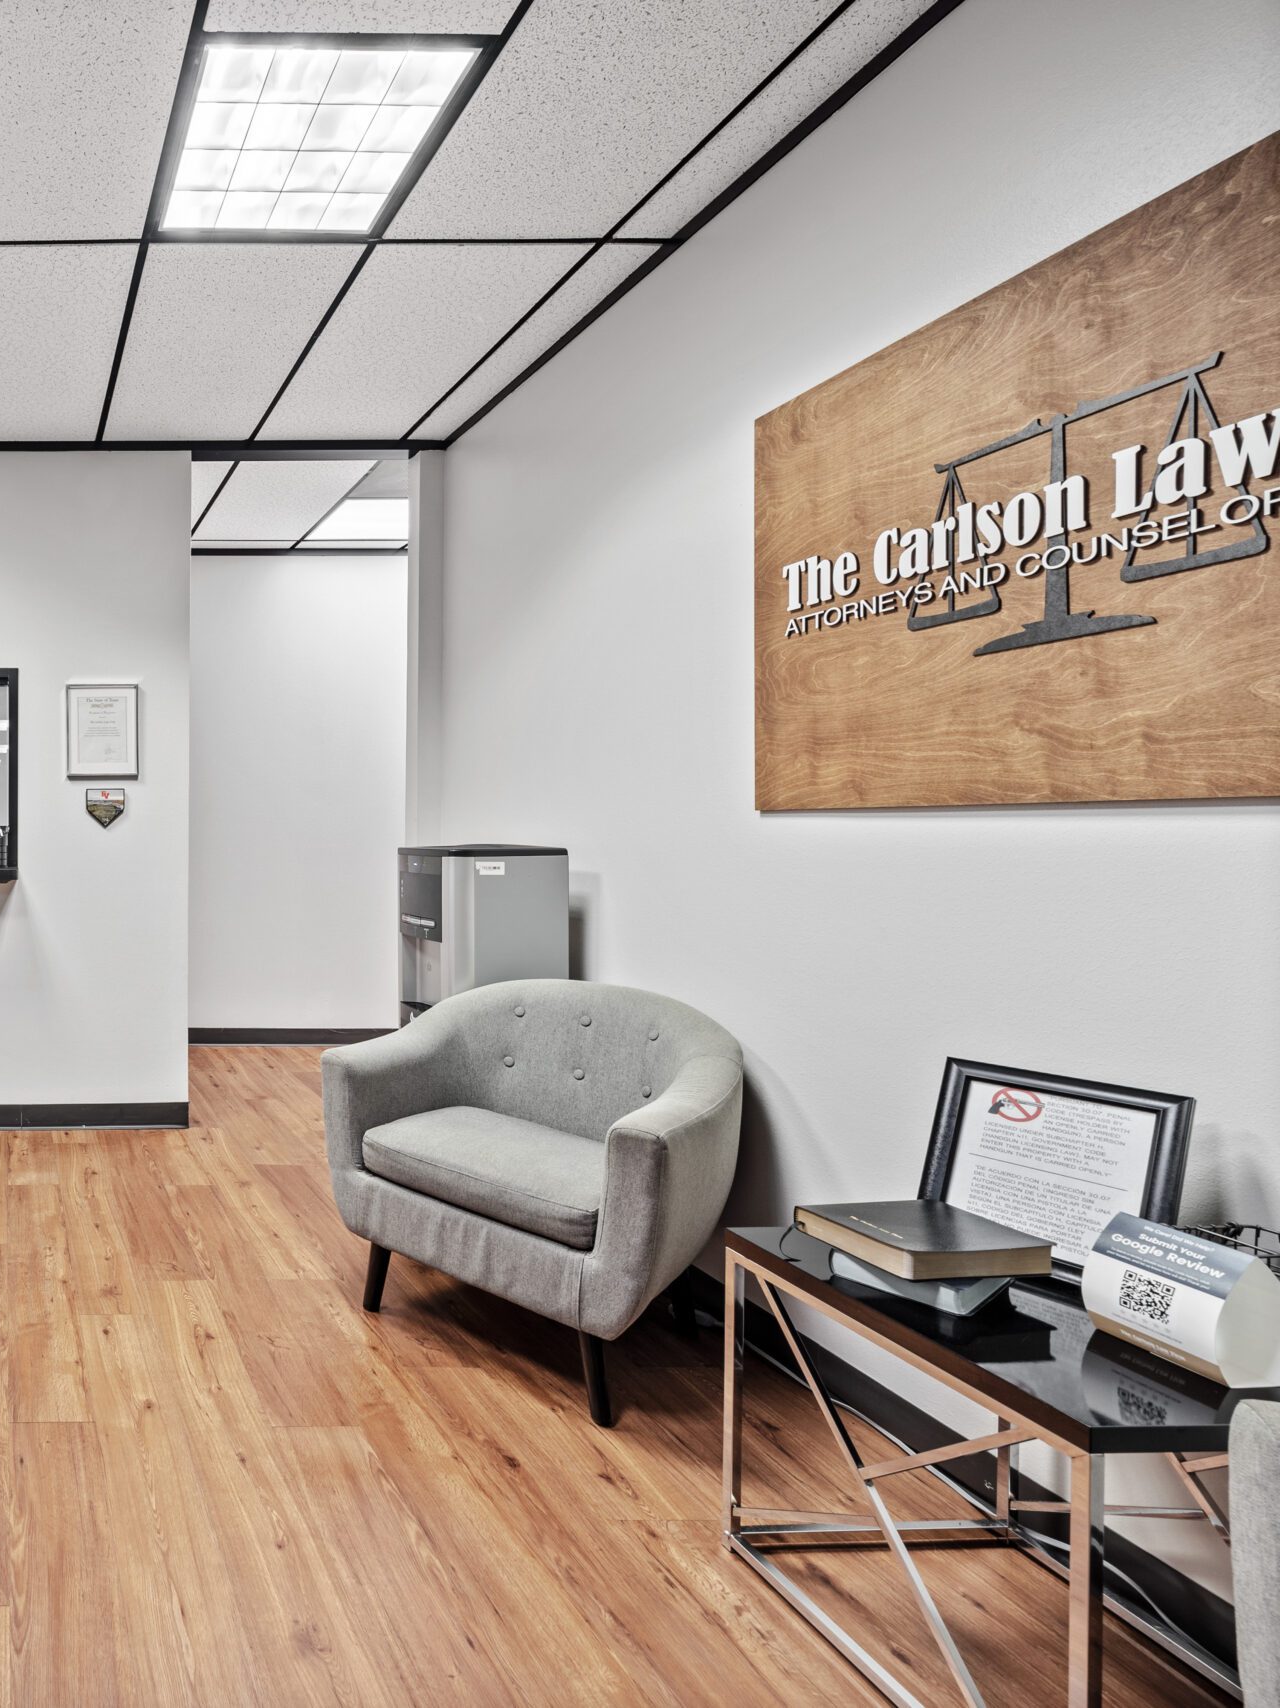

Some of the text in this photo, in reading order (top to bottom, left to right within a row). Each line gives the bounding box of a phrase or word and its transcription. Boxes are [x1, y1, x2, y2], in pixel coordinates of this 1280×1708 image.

[782, 407, 1280, 612] The Carlson Law
[785, 581, 934, 637] ATTORNEYS
[939, 562, 1007, 599] AND
[1045, 1106, 1065, 1115] CODE
[984, 1120, 1018, 1131] LICENSED
[1018, 1127, 1044, 1137] UNDER
[1045, 1133, 1095, 1148] SUBCHAPTER
[1044, 1112, 1130, 1134] LICENSE HOLDER WITH
[1055, 1121, 1084, 1131] OPENLY
[1086, 1127, 1121, 1139] CARRIED
[981, 1137, 1003, 1146] ENTER
[1022, 1146, 1061, 1159] PROPERTY
[1062, 1156, 1081, 1164] WITH
[983, 1126, 1015, 1136] CHAPTER
[1031, 1136, 1081, 1151] GOVERNMENT
[1083, 1148, 1106, 1157] CODE
[1093, 1135, 1126, 1146] PERSON
[979, 1143, 1013, 1155] HANDGUN
[1015, 1151, 1033, 1159] THAT
[1043, 1158, 1077, 1169] CARRIED
[1020, 1140, 1058, 1152] LICENSING
[1083, 1154, 1100, 1162] MAY
[1101, 1158, 1119, 1166] NOT
[987, 1167, 1022, 1180] ACUERDO
[1023, 1176, 1039, 1184] CON
[1017, 1180, 1040, 1190] PENAL
[995, 1194, 1010, 1202] UNA
[1011, 1198, 1046, 1211] PERSONA
[1047, 1207, 1065, 1216] CON
[1002, 1189, 1018, 1197] CON
[1020, 1194, 1035, 1202] UNA
[1037, 1198, 1068, 1210] PISTOLA
[1049, 1195, 1080, 1206] TITULAR
[1094, 1206, 1111, 1214] UNA
[1028, 1222, 1049, 1231] PARA
[1050, 1228, 1082, 1240] PORTAR
[1172, 1233, 1183, 1242] Did
[1184, 1238, 1195, 1246] We
[1111, 1233, 1165, 1257] Google
[1166, 1252, 1225, 1279] Review
[1138, 1233, 1206, 1260] Submit Your
